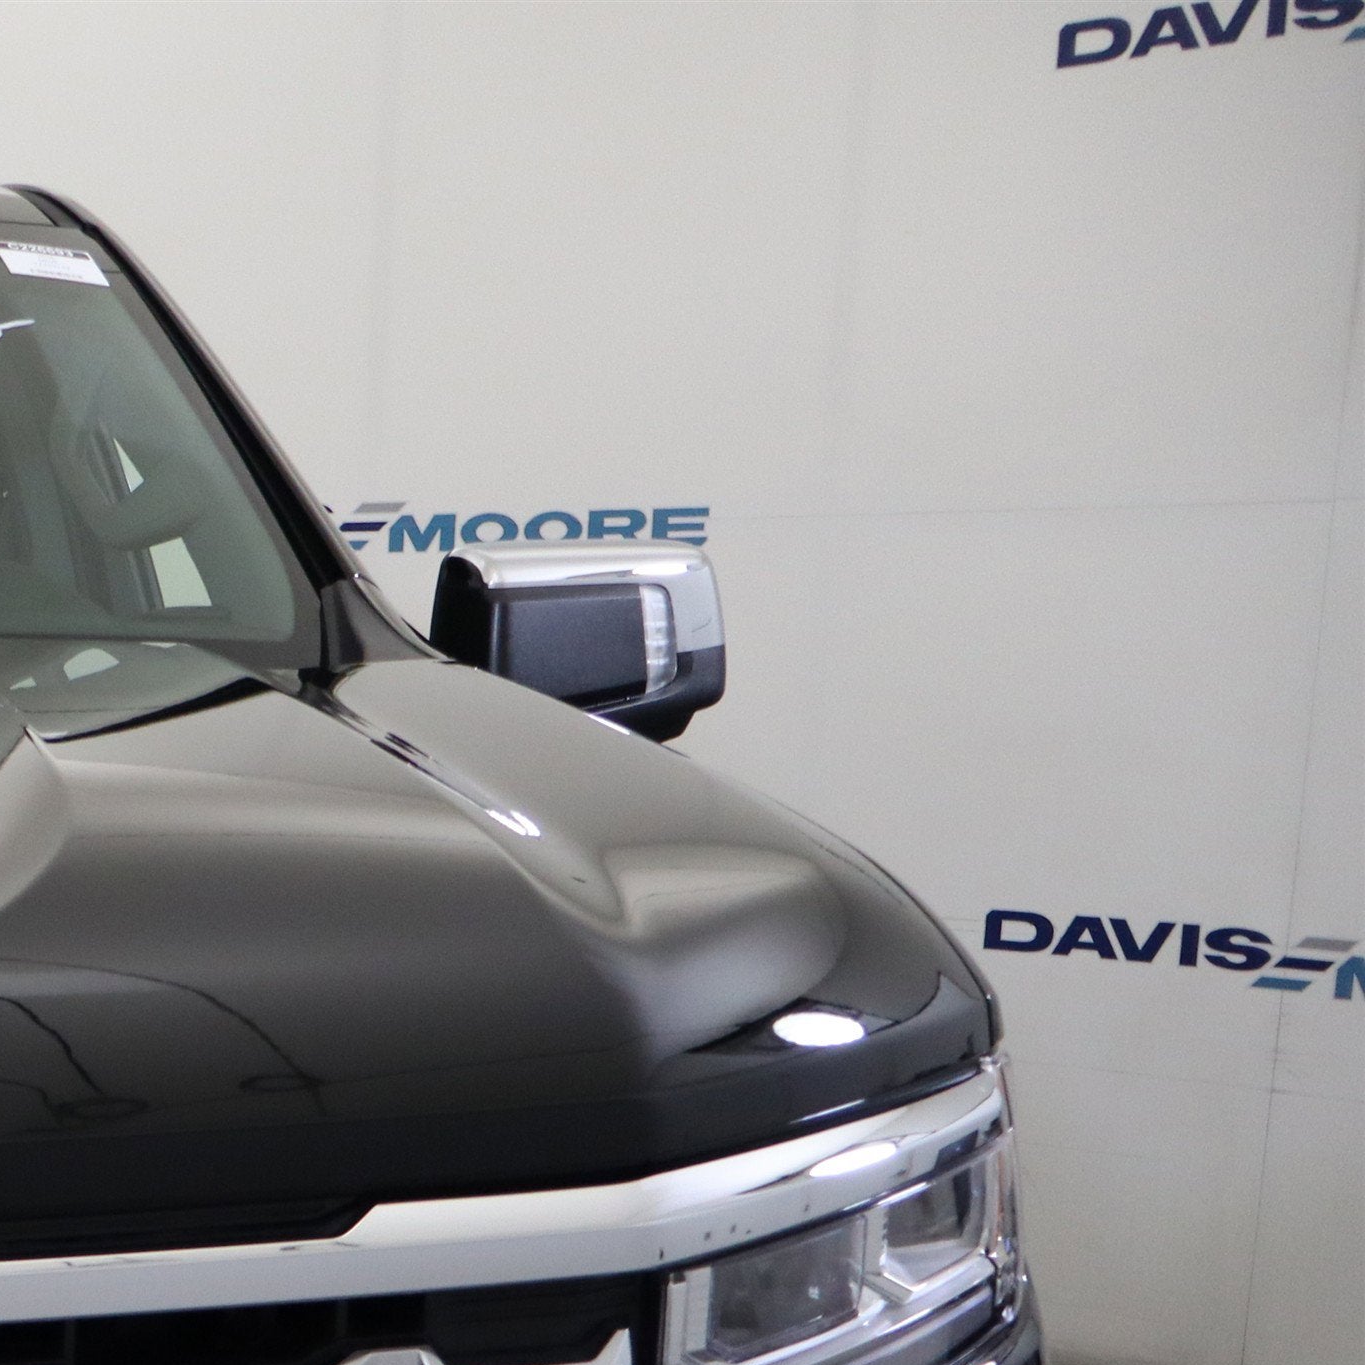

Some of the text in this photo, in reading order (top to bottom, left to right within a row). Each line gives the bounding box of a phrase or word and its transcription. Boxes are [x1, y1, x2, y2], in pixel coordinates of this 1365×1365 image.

[1056, 0, 1365, 69] DAVIS
[387, 506, 710, 553] MOORE
[983, 908, 1274, 972] DAVIS
